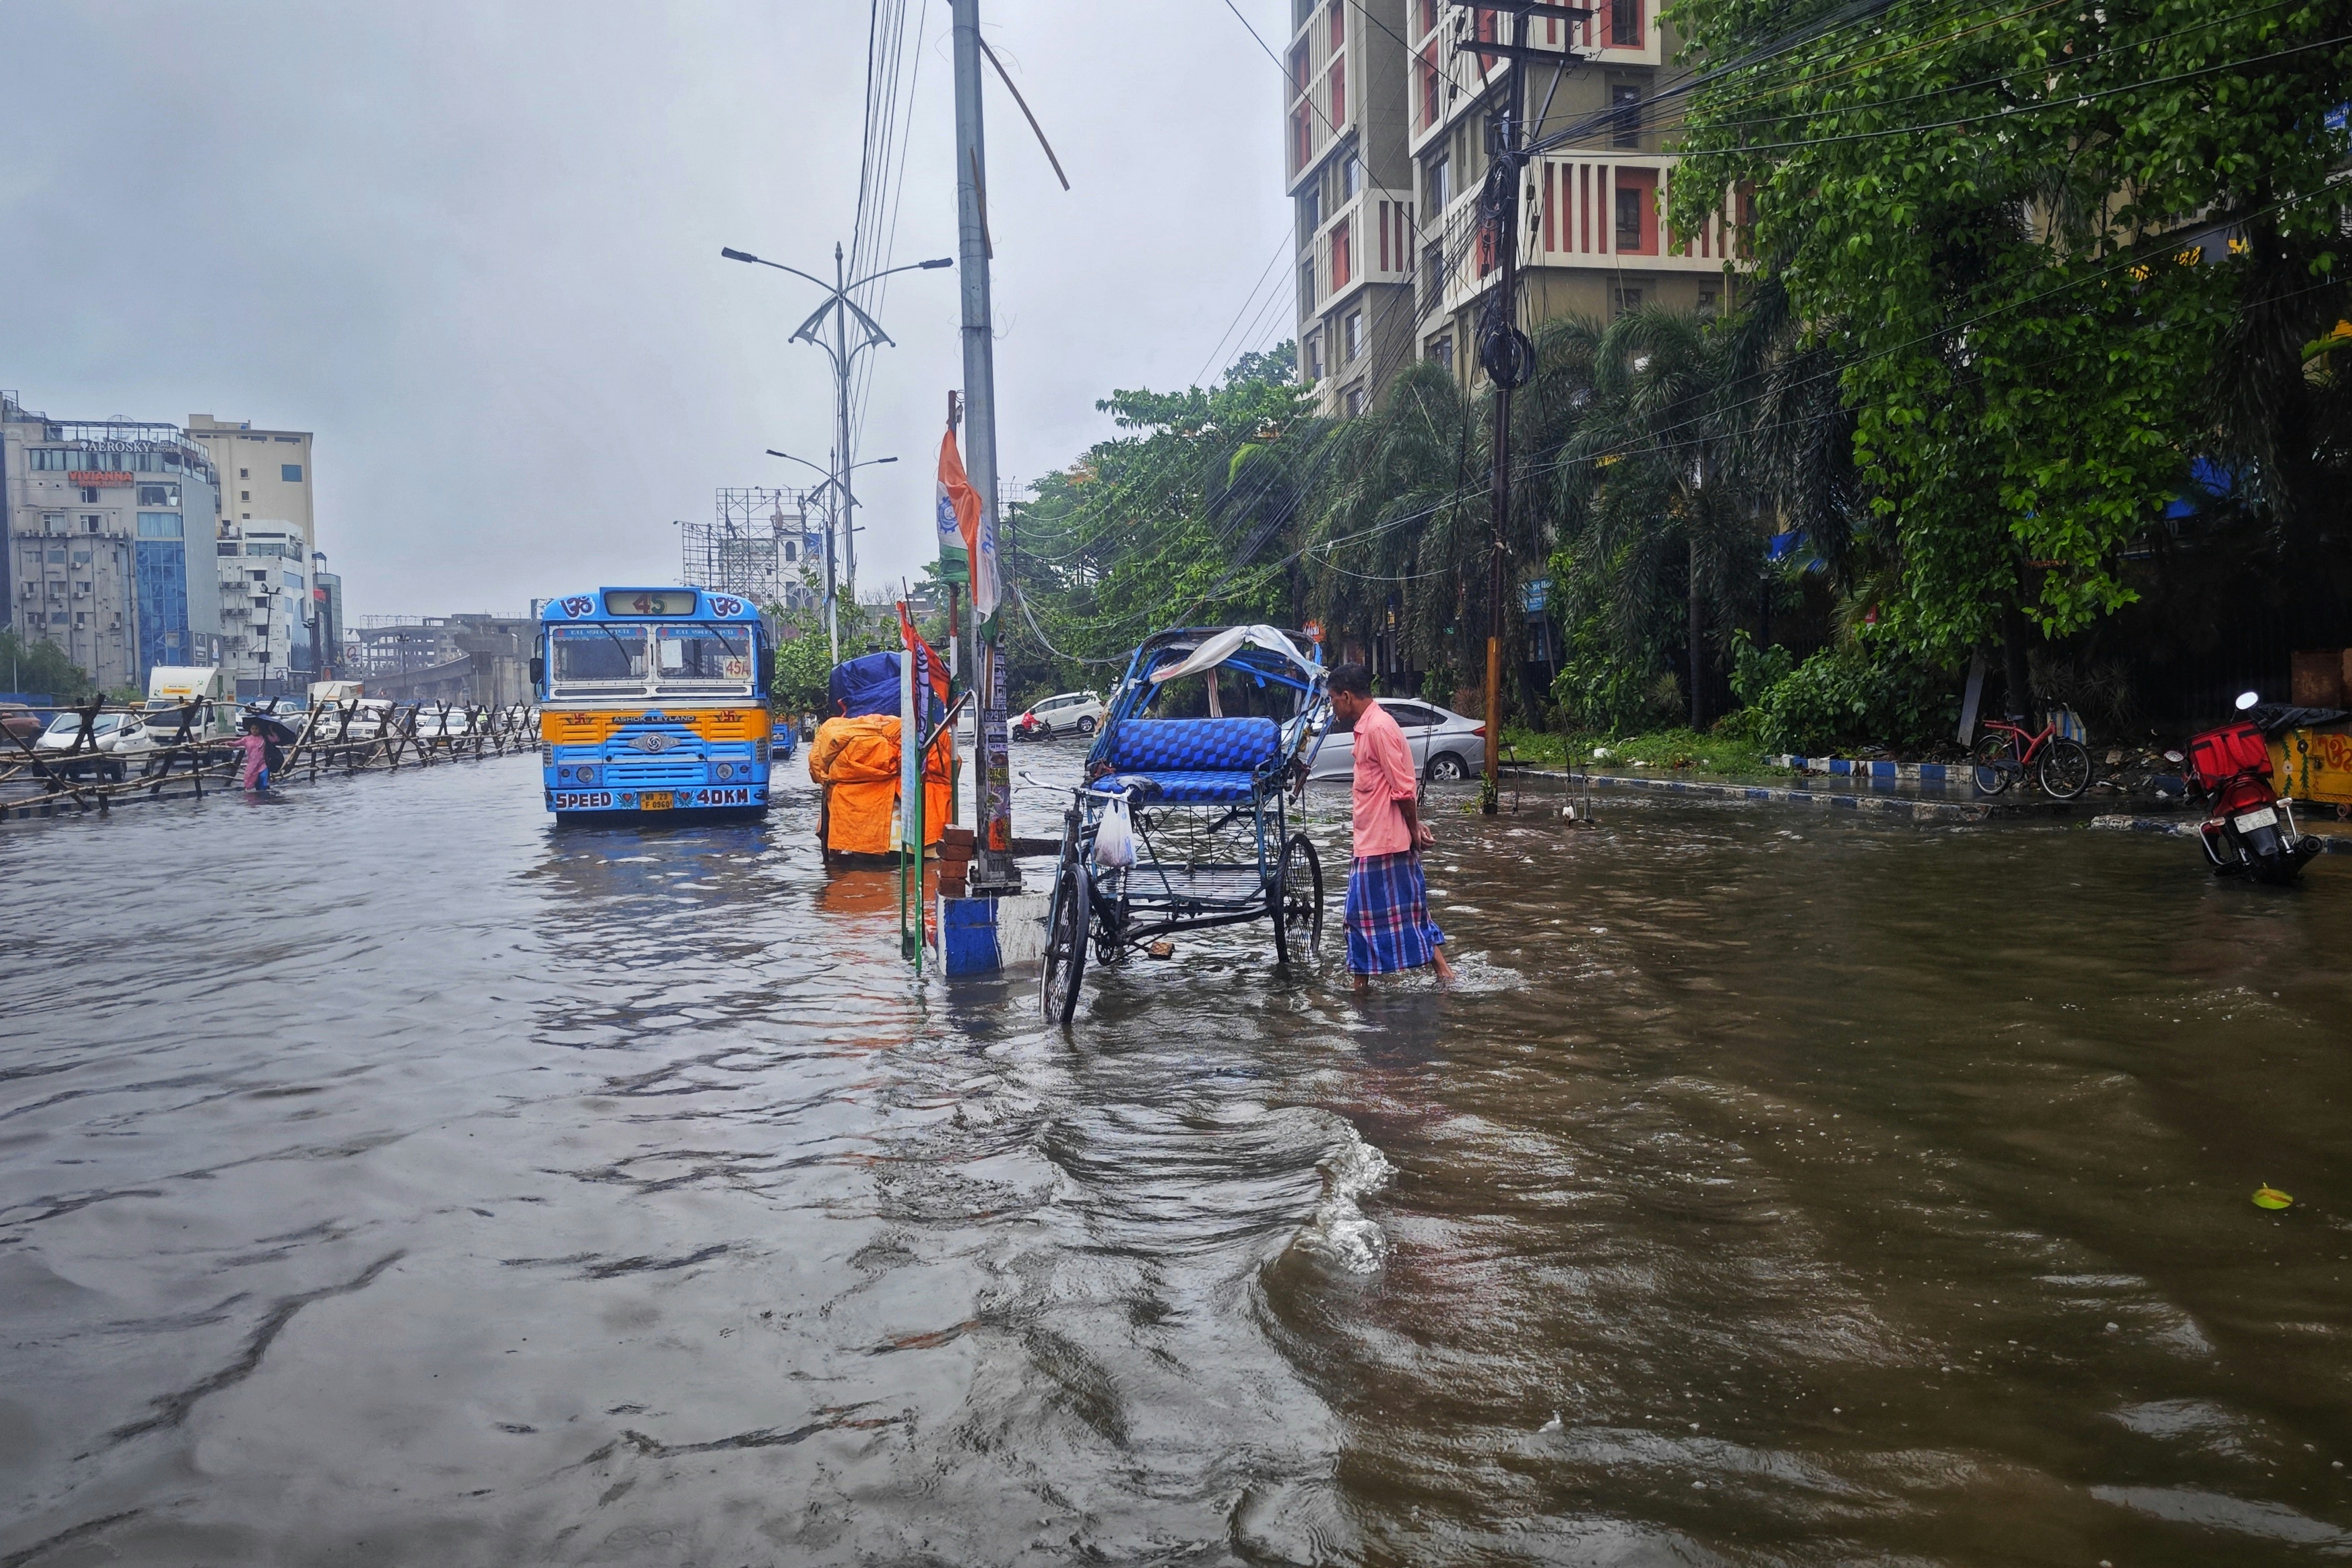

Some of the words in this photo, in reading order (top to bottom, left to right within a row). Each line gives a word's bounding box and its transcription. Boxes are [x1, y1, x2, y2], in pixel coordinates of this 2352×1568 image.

[89, 441, 151, 452] AEROSKY
[69, 472, 132, 480] VIVIANNA
[633, 594, 667, 614] 45
[727, 661, 749, 676] 45A
[556, 792, 612, 808] SPEED
[697, 789, 748, 804] 40KM
